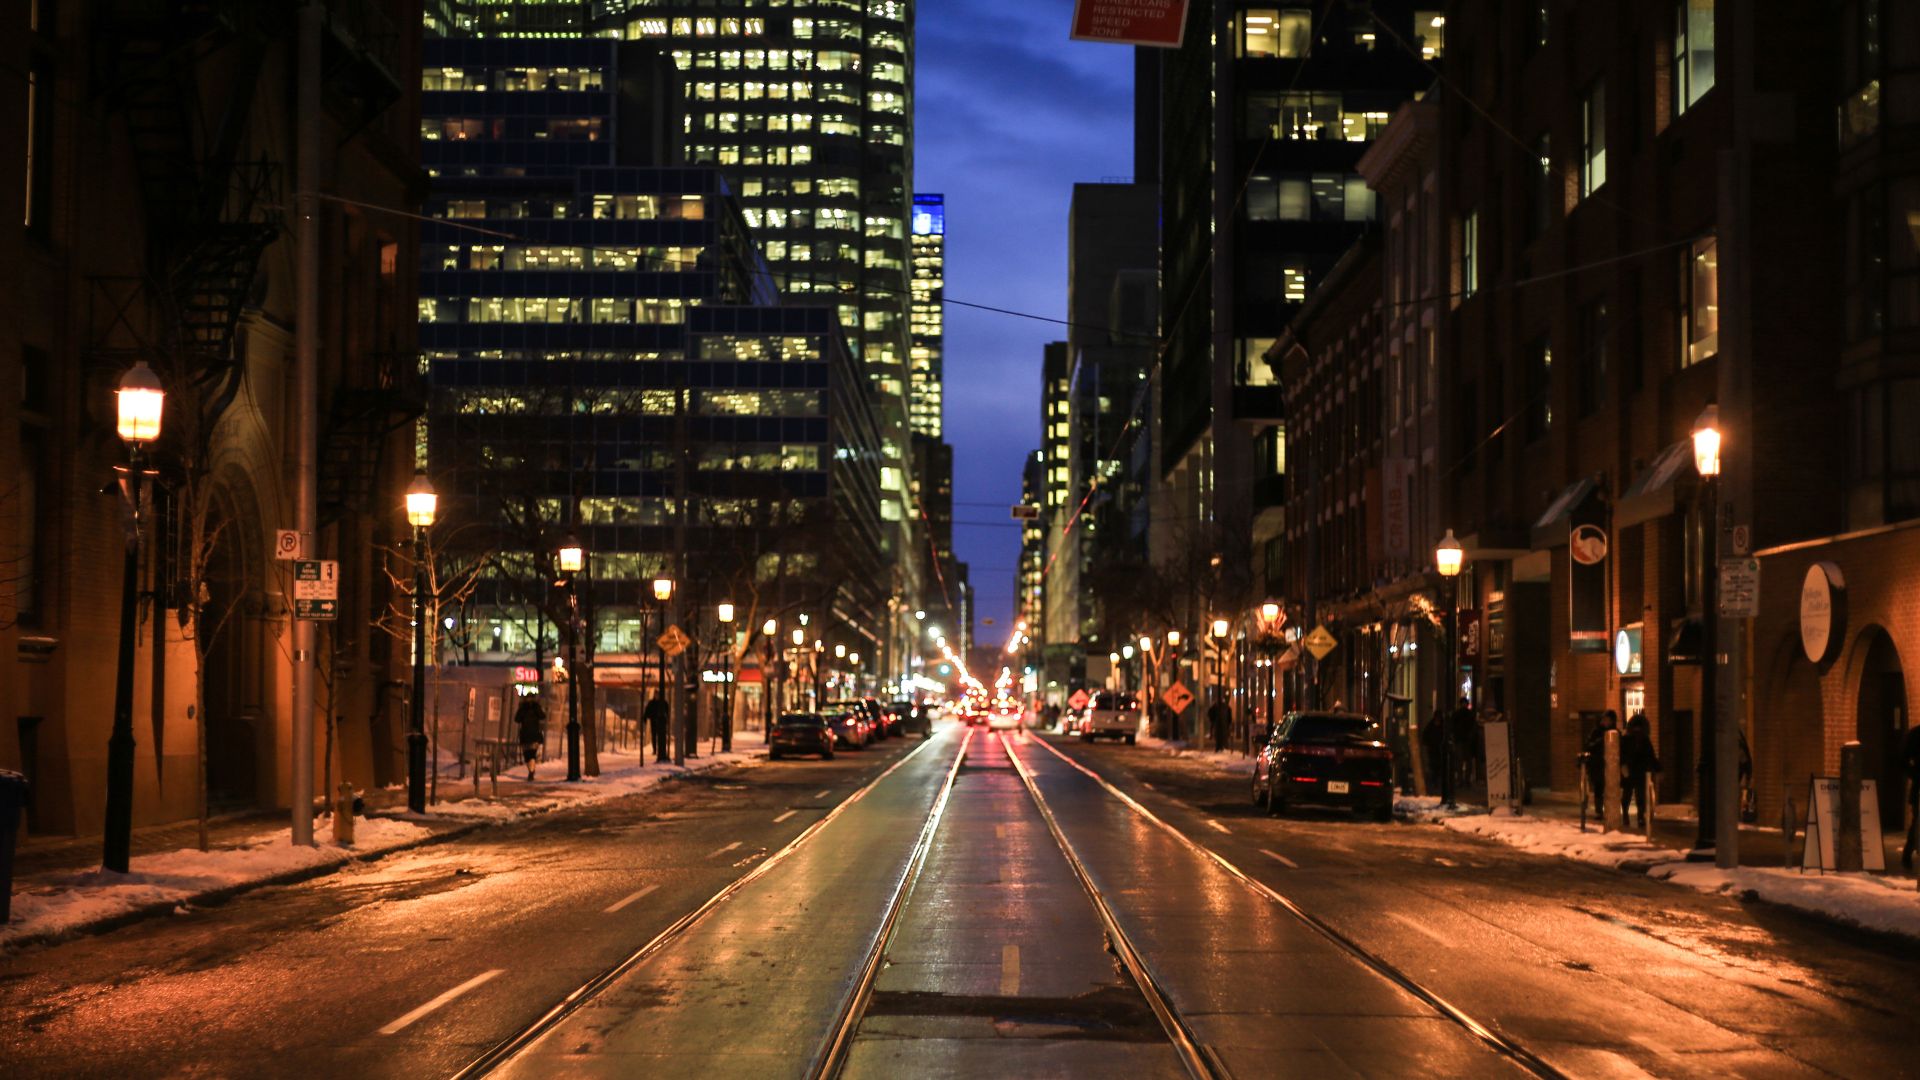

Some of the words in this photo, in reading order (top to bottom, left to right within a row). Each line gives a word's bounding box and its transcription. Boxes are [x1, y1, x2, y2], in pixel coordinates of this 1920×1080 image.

[1093, 5, 1165, 18] RESTRICTED
[1092, 16, 1130, 26] SPEED
[1091, 26, 1121, 37] ZONE
